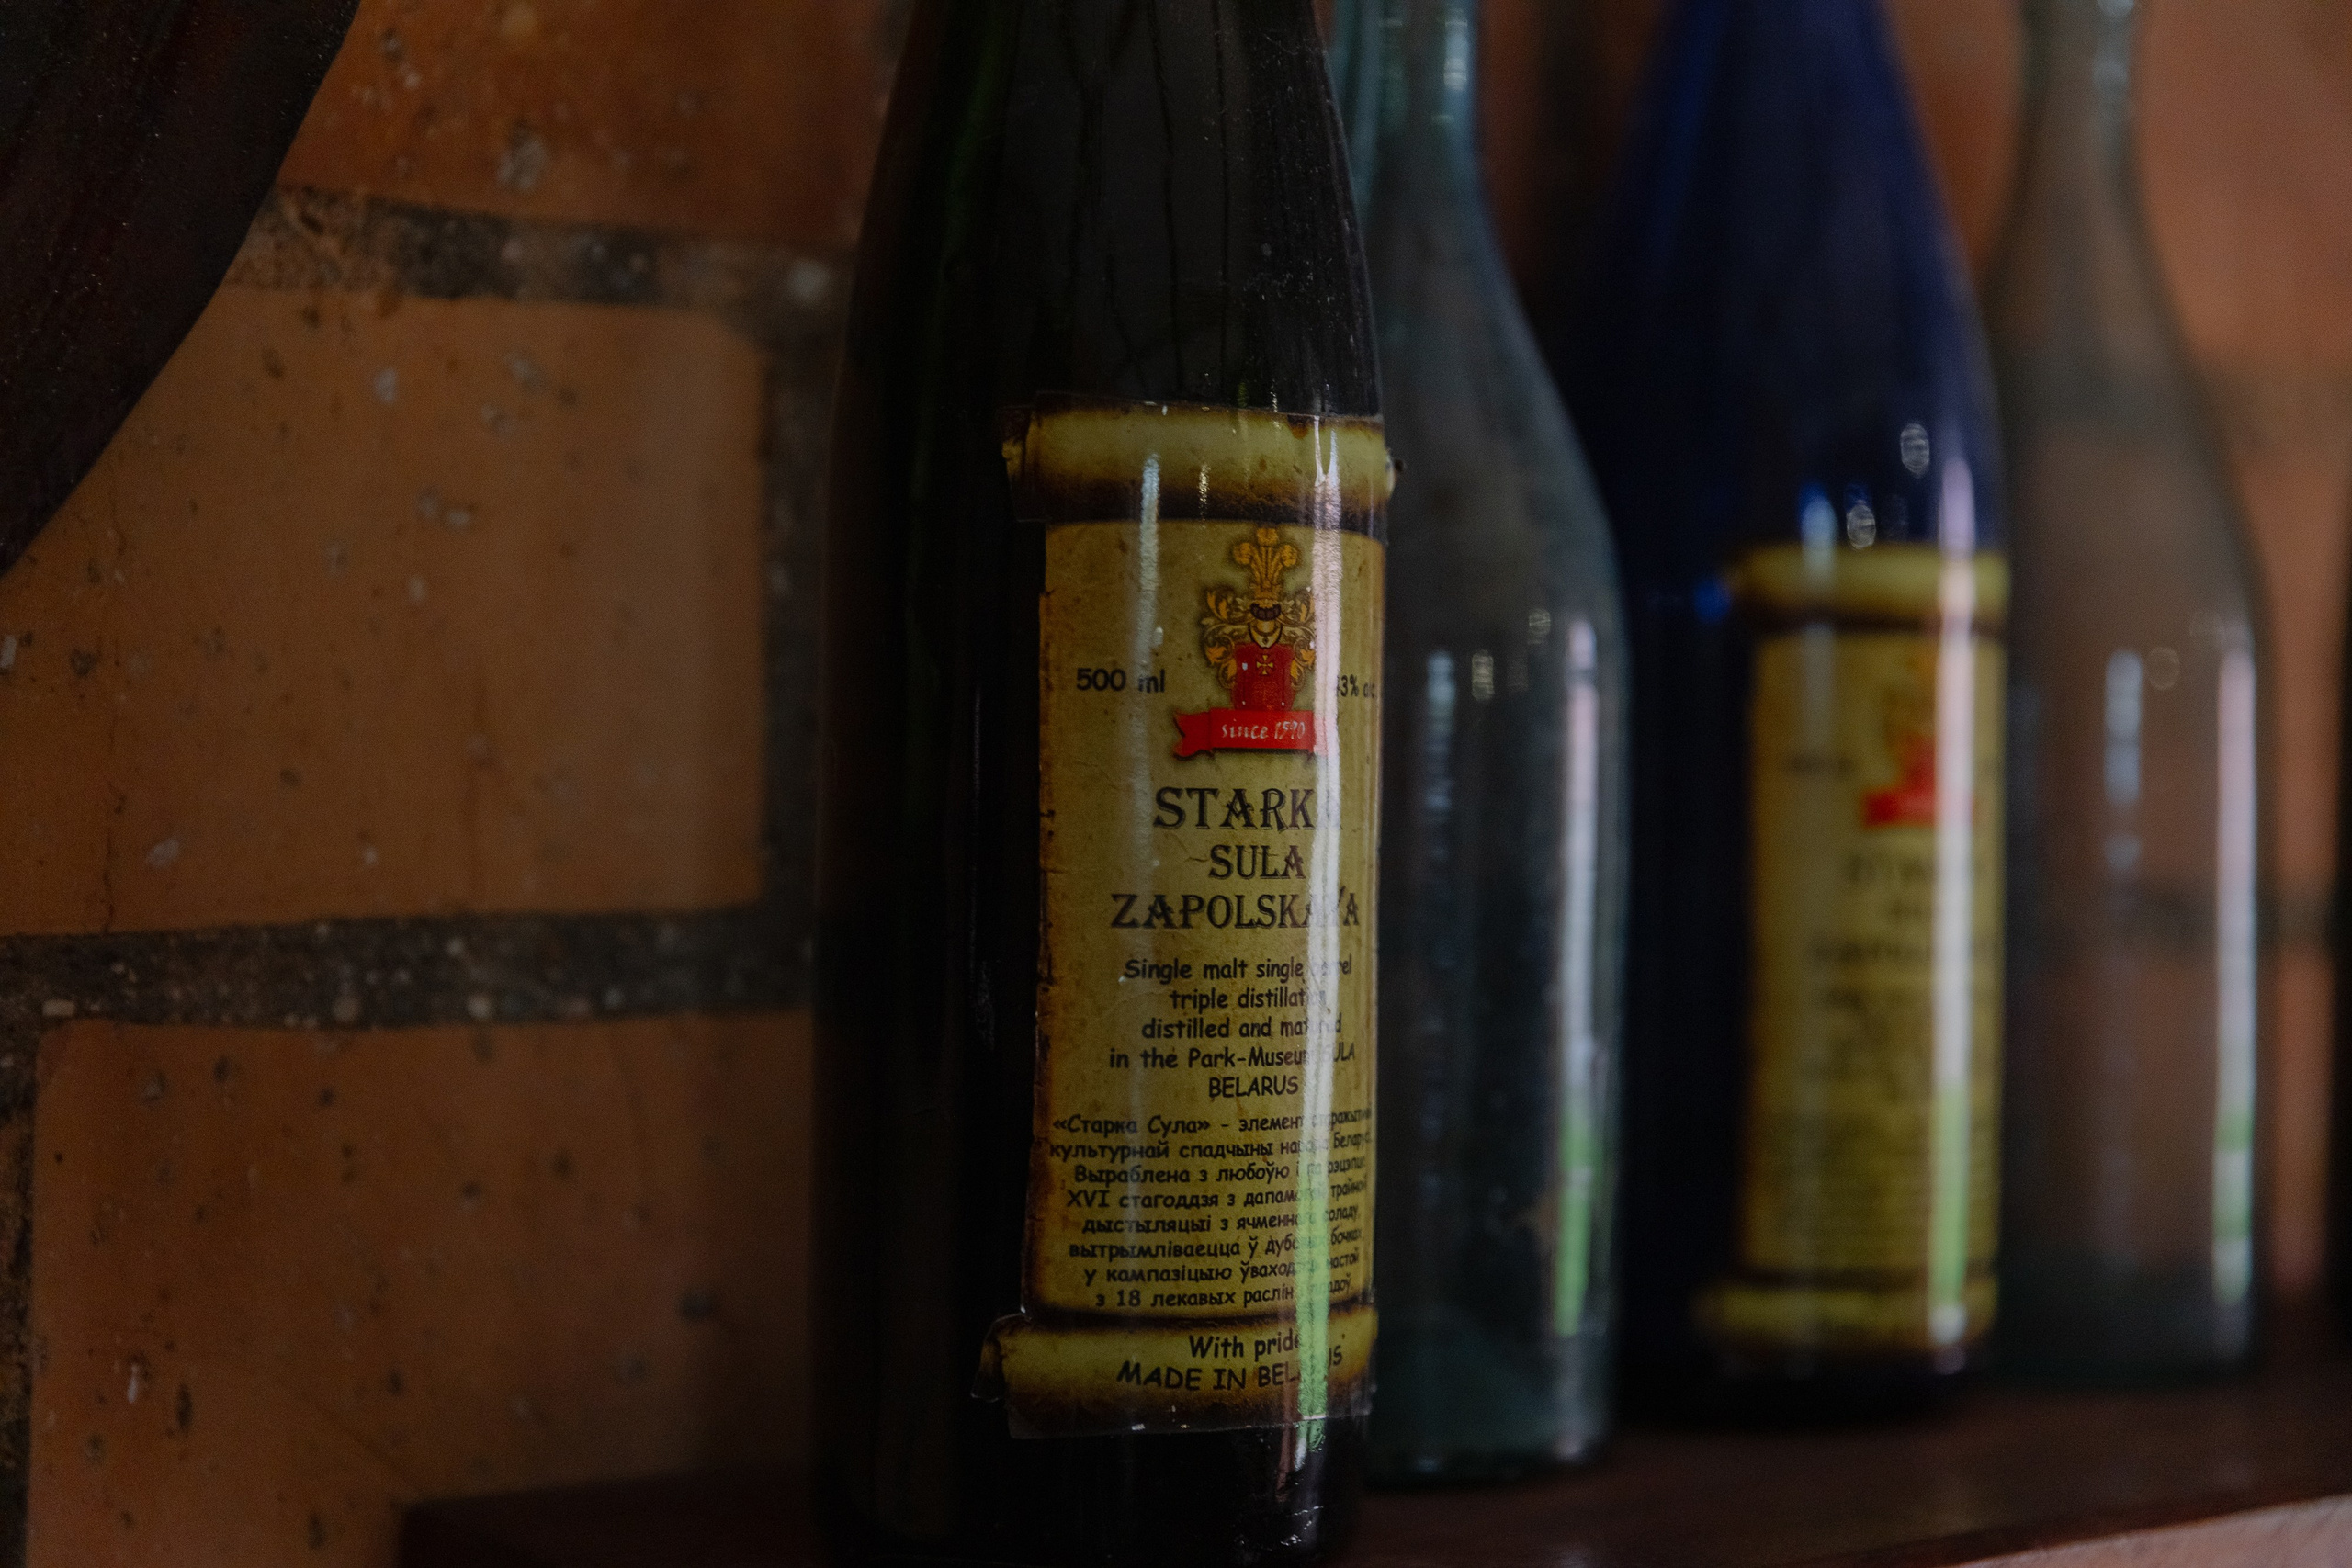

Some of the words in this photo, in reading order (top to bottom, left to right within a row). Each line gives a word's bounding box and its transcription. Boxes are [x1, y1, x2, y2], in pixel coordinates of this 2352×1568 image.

[1076, 668, 1126, 692] 500
[1137, 669, 1165, 694] ml
[1222, 718, 1269, 739] since
[1153, 786, 1342, 830] STARK
[1208, 844, 1306, 880] SULA
[1110, 886, 1360, 930] ZAPOLSKA
[1124, 959, 1193, 985] Single
[1203, 959, 1248, 980] malt
[1256, 956, 1304, 984] single
[1170, 987, 1229, 1015] triple
[1238, 986, 1327, 1010] distillat
[1142, 1017, 1230, 1040] distilled
[1239, 1016, 1272, 1038] and
[1280, 1012, 1342, 1038] matd
[1110, 1049, 1129, 1069] in
[1140, 1048, 1179, 1069] the
[1188, 1046, 1316, 1069] Park-Museu
[1208, 1075, 1299, 1099] BELARUS
[1053, 1113, 1137, 1138] «Старка
[1148, 1114, 1210, 1139] Сула»
[1050, 1139, 1170, 1164] культурнай
[1180, 1141, 1273, 1160] спадчыны
[1074, 1164, 1190, 1188] Выраблена
[1199, 1168, 1208, 1182] з
[1216, 1161, 1290, 1184] любоўю
[1067, 1189, 1110, 1208] XVI
[1119, 1194, 1219, 1210] стагоддзя
[1227, 1193, 1236, 1207] з
[1082, 1215, 1211, 1235] дыстыляцыі
[1220, 1218, 1228, 1231] з
[1069, 1240, 1240, 1262] вытрымліваецца
[1249, 1235, 1259, 1258] ў
[1084, 1269, 1097, 1286] у
[1106, 1265, 1232, 1284] кампазіцыю
[1095, 1293, 1105, 1307] з
[1117, 1288, 1141, 1307] 18
[1150, 1289, 1236, 1307] лекавых
[1244, 1283, 1294, 1308] раслін
[1189, 1335, 1244, 1359] With
[1117, 1361, 1203, 1391] MADE
[1213, 1368, 1246, 1391] IN
[1258, 1345, 1343, 1388] BELS
